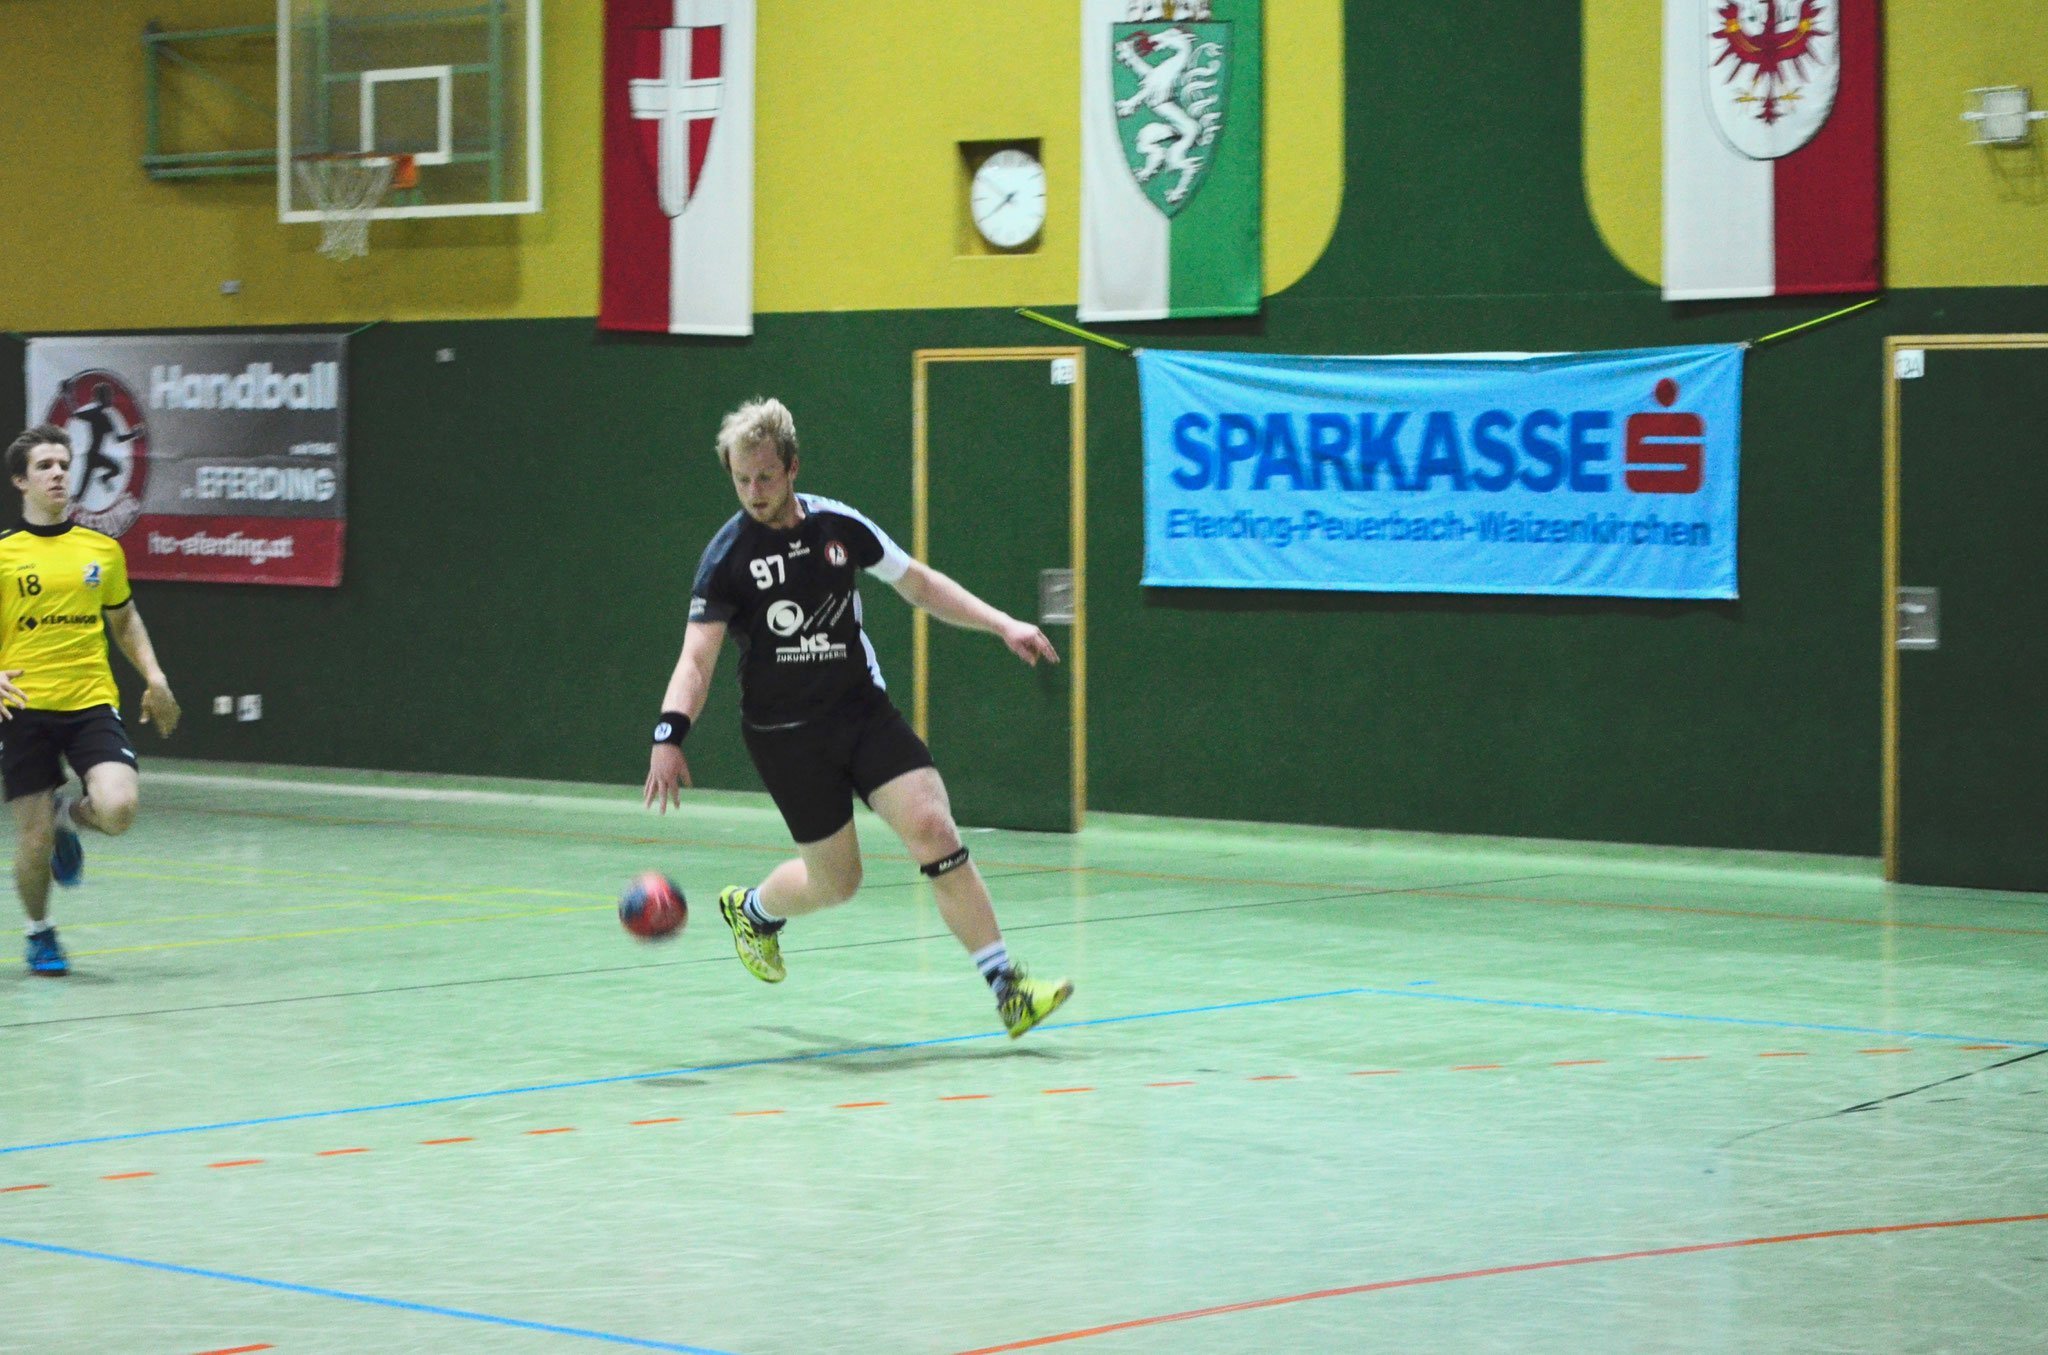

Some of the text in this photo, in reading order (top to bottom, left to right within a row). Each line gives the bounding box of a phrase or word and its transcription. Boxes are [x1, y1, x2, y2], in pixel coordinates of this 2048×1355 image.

[150, 362, 338, 410] Handball
[1171, 409, 1614, 492] SPARKASSE
[18, 574, 42, 598] 18
[749, 554, 786, 590] 97
